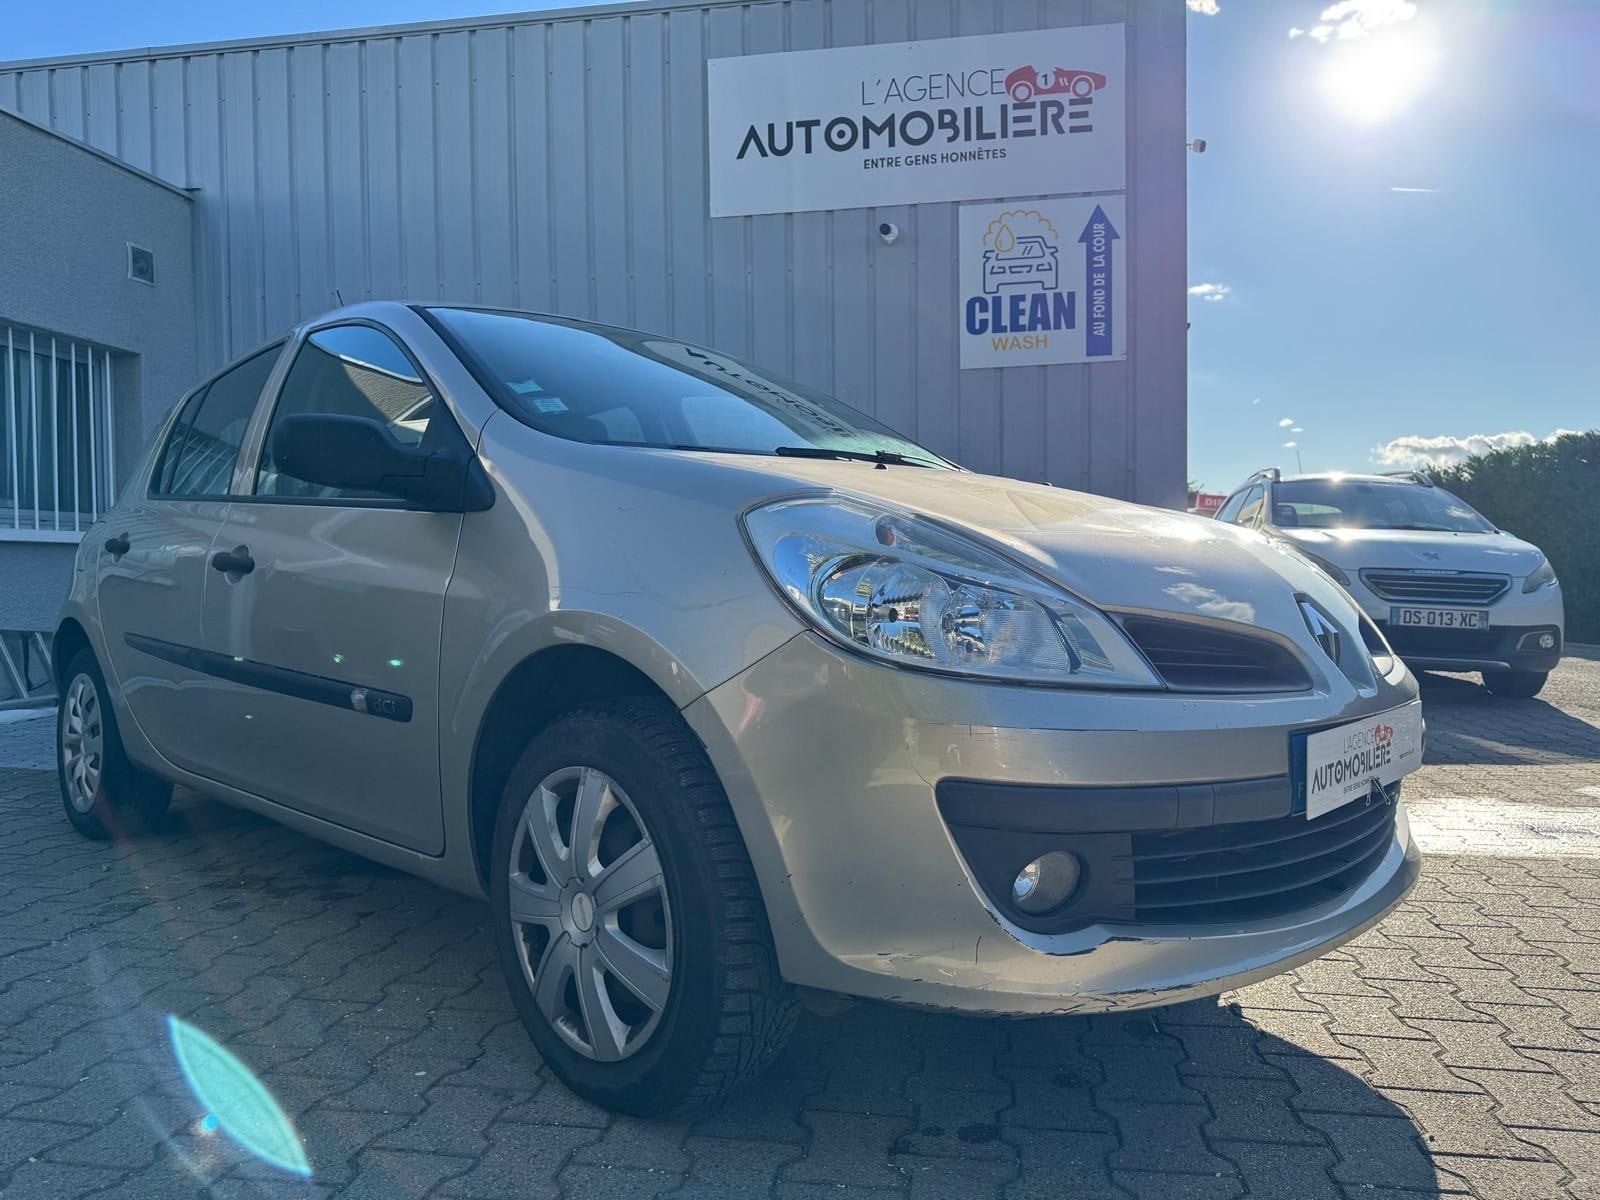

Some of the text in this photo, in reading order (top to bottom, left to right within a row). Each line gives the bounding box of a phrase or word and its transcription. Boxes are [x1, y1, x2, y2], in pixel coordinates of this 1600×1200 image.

[861, 68, 1006, 106] L'AGENCE
[1041, 73, 1049, 86] 1
[863, 147, 1007, 170] ENTRE GENS HONNÊTES
[1093, 223, 1106, 337] AU FOND DE LA COUR
[966, 291, 1076, 335] CLEAN
[991, 335, 1048, 352] WASH
[1343, 727, 1375, 754] L'AGENCE
